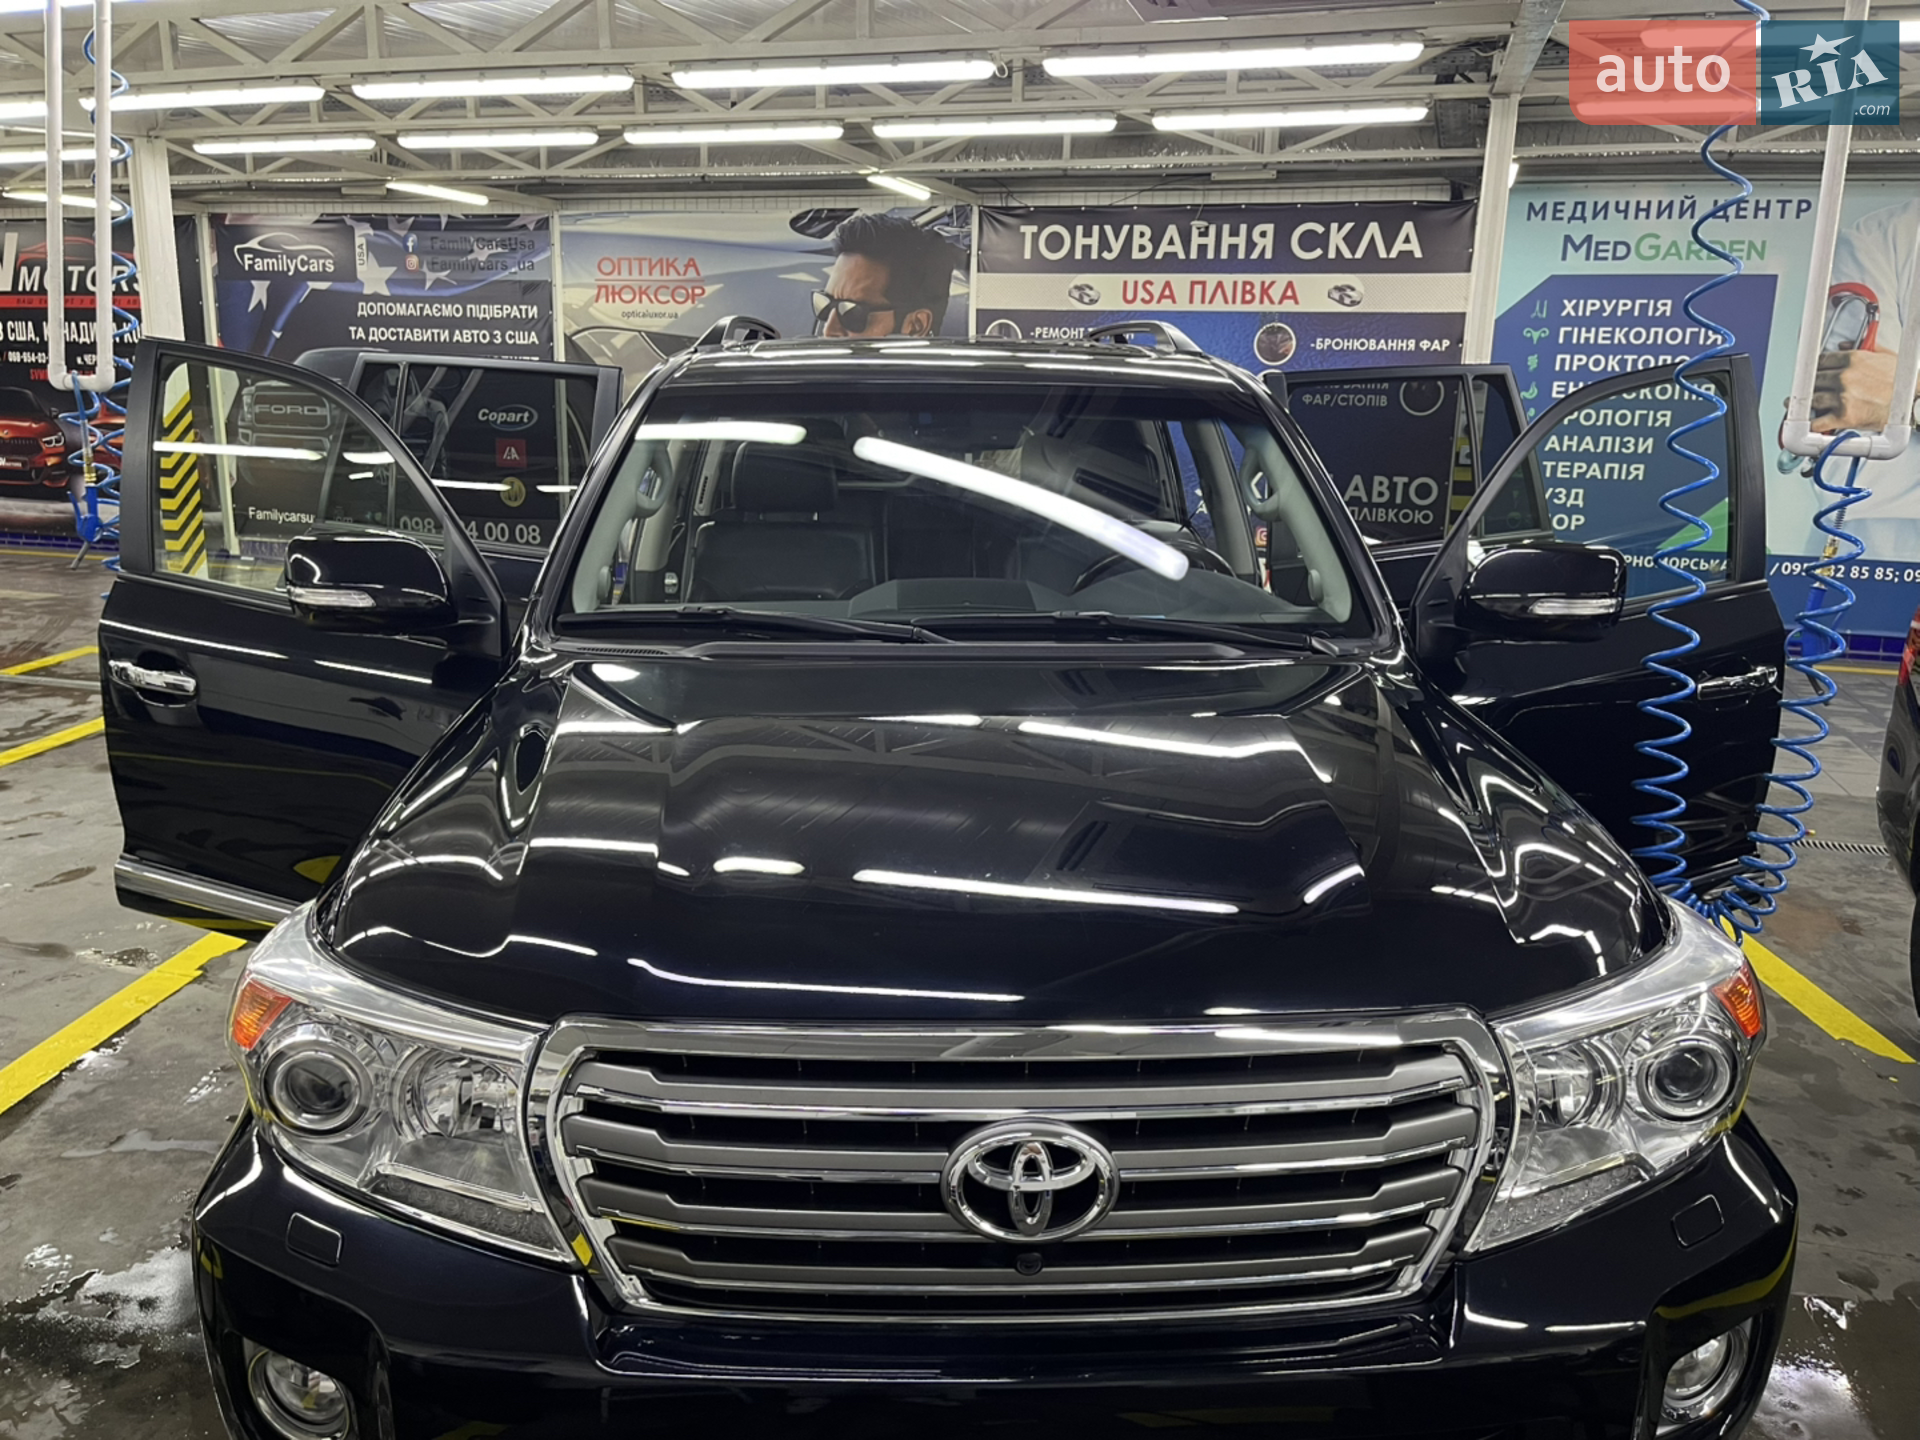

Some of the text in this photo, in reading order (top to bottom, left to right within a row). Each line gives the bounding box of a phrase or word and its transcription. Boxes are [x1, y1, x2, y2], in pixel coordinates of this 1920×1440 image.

[1526, 195, 1813, 224] МЕДИЧНИЙ ЦЕНТР
[1019, 221, 1423, 260] ТОНУВАННЯ СКЛА
[244, 253, 335, 276] FamilyCars
[356, 243, 366, 267] USA
[597, 256, 700, 276] ОПТИКА
[594, 284, 706, 305] ЛЮКСОР
[1121, 279, 1300, 305] USA ПЛІВКА
[357, 302, 538, 319] ДОПОМАГАЄМО ПІДІБРАТИ
[621, 309, 679, 321] opticaluxor.ua
[1560, 299, 1673, 317] ХІРУРГІЯ
[349, 326, 365, 340] ТА
[368, 326, 449, 343] ДОСТАВИТИ
[453, 329, 490, 344] АВТО
[505, 330, 539, 345] США
[1310, 338, 1451, 352] -БРОНЮВАННЯ ФАР
[1558, 327, 1723, 345] ГІНЕКОЛОГІЯ
[255, 404, 319, 415] FORD
[1301, 393, 1388, 407] ФАР/СТОПІВ
[478, 408, 530, 424] Copart
[1544, 435, 1654, 454] АНАЛІЗИ
[1543, 461, 1646, 481] ТЕРАПІЯ
[1343, 474, 1439, 506] АВТО
[1349, 506, 1434, 525] ПЛІВКОЮ
[1549, 513, 1586, 531] ОР
[483, 522, 509, 542] 00
[515, 523, 541, 545] 08
[1849, 565, 1870, 579] 85
